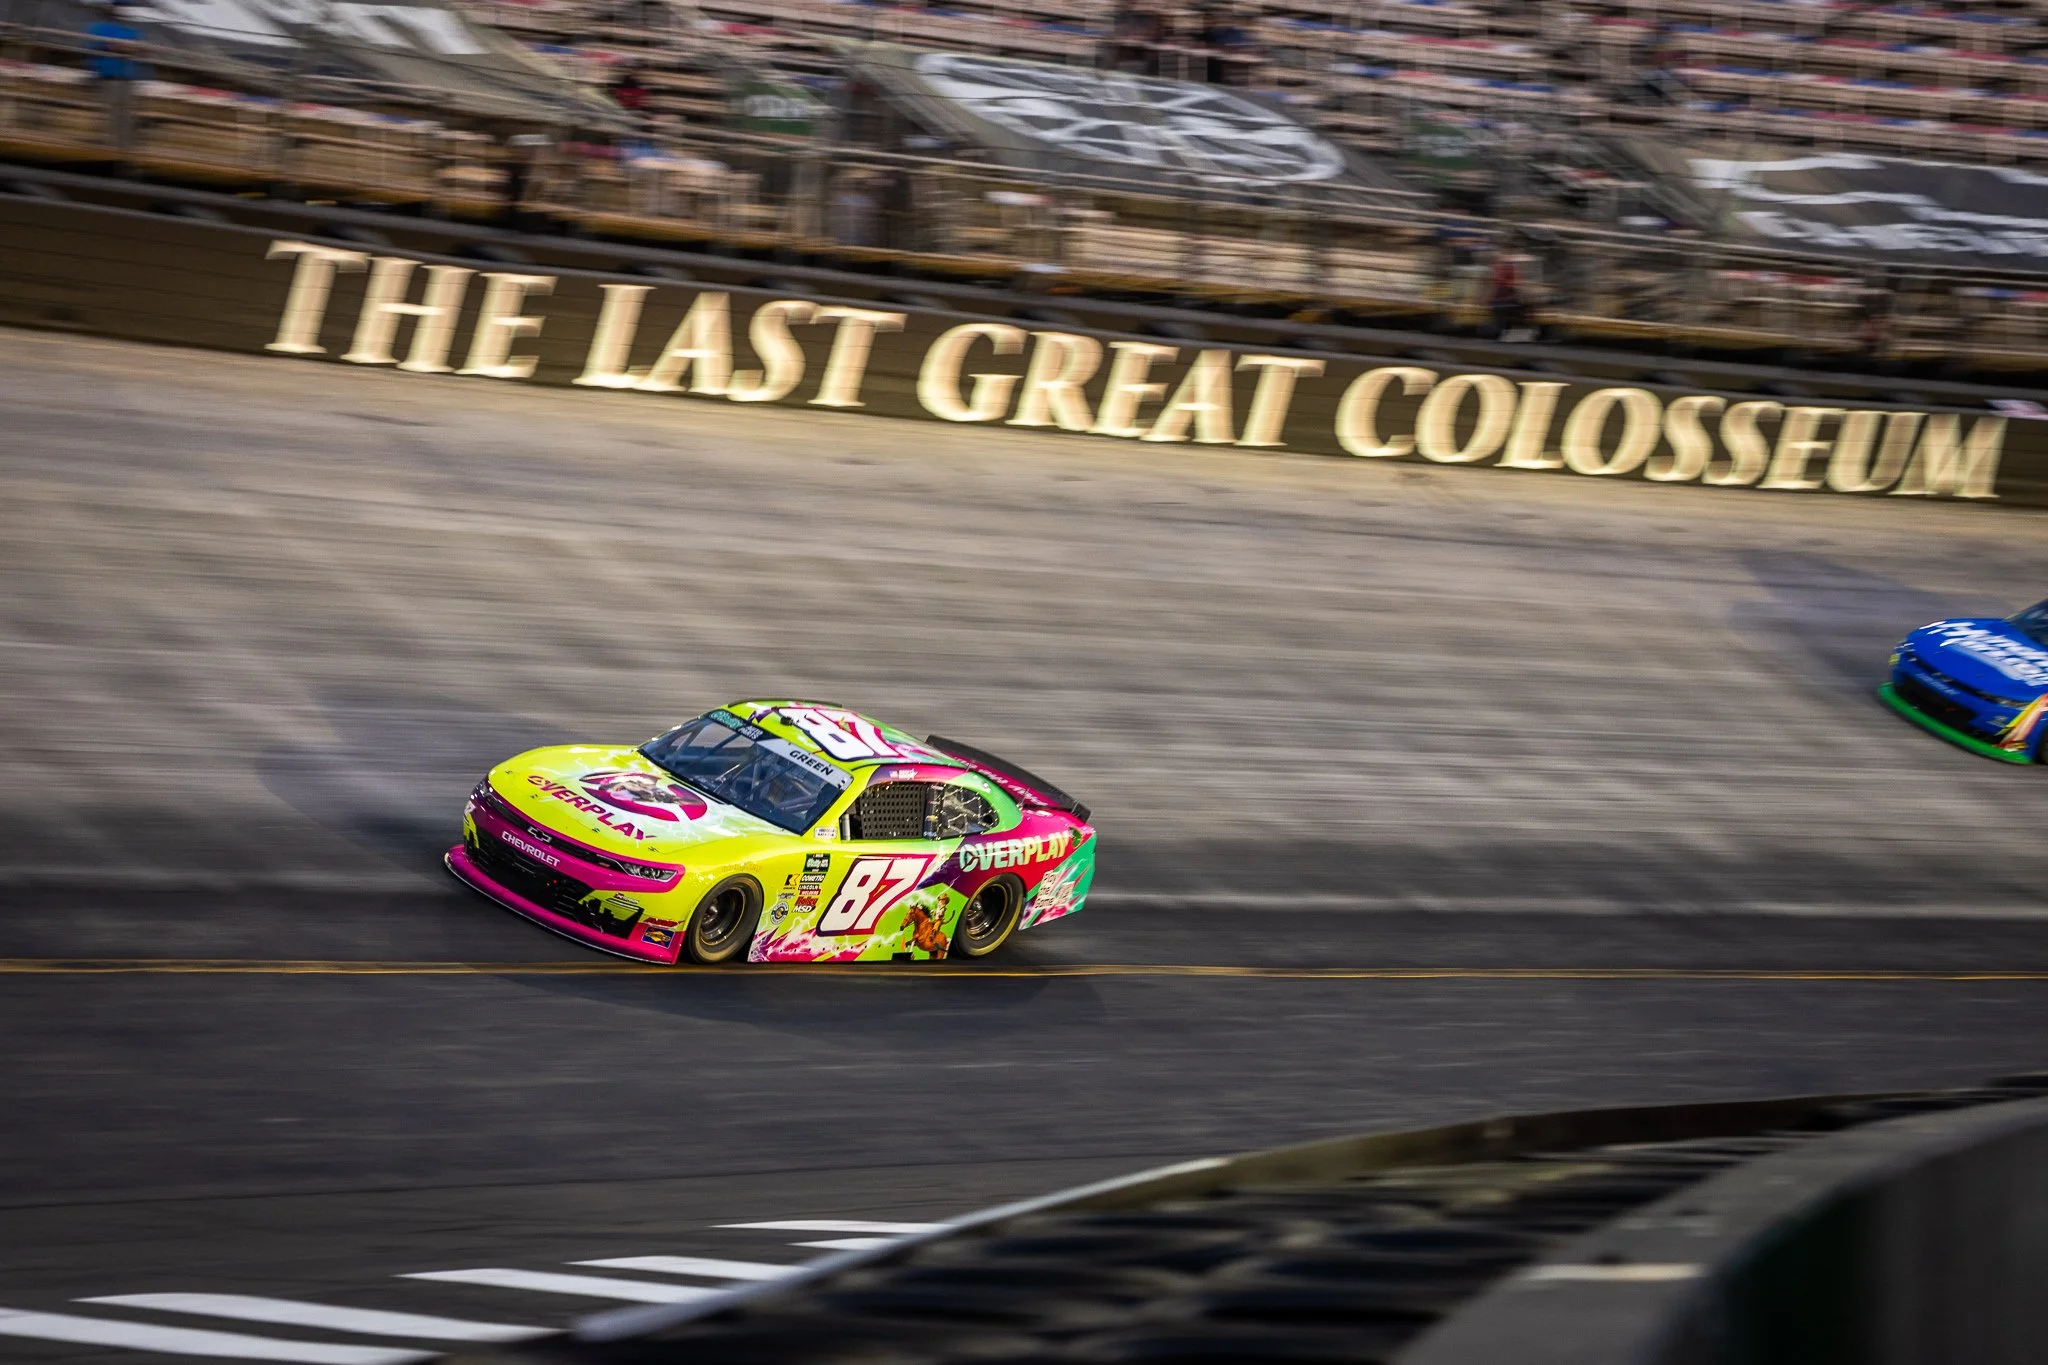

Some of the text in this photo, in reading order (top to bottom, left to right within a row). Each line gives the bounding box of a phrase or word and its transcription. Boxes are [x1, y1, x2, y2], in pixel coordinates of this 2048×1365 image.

[265, 239, 2008, 500] THE LAST GREAT COLOSSEUM
[777, 708, 906, 761] 87
[789, 750, 834, 776] GREEN
[527, 775, 658, 841] OVERPLAY
[501, 831, 560, 867] CHEVROLET
[960, 830, 1070, 873] OVERPLAY
[793, 905, 812, 913] MSD
[818, 856, 934, 935] 87
